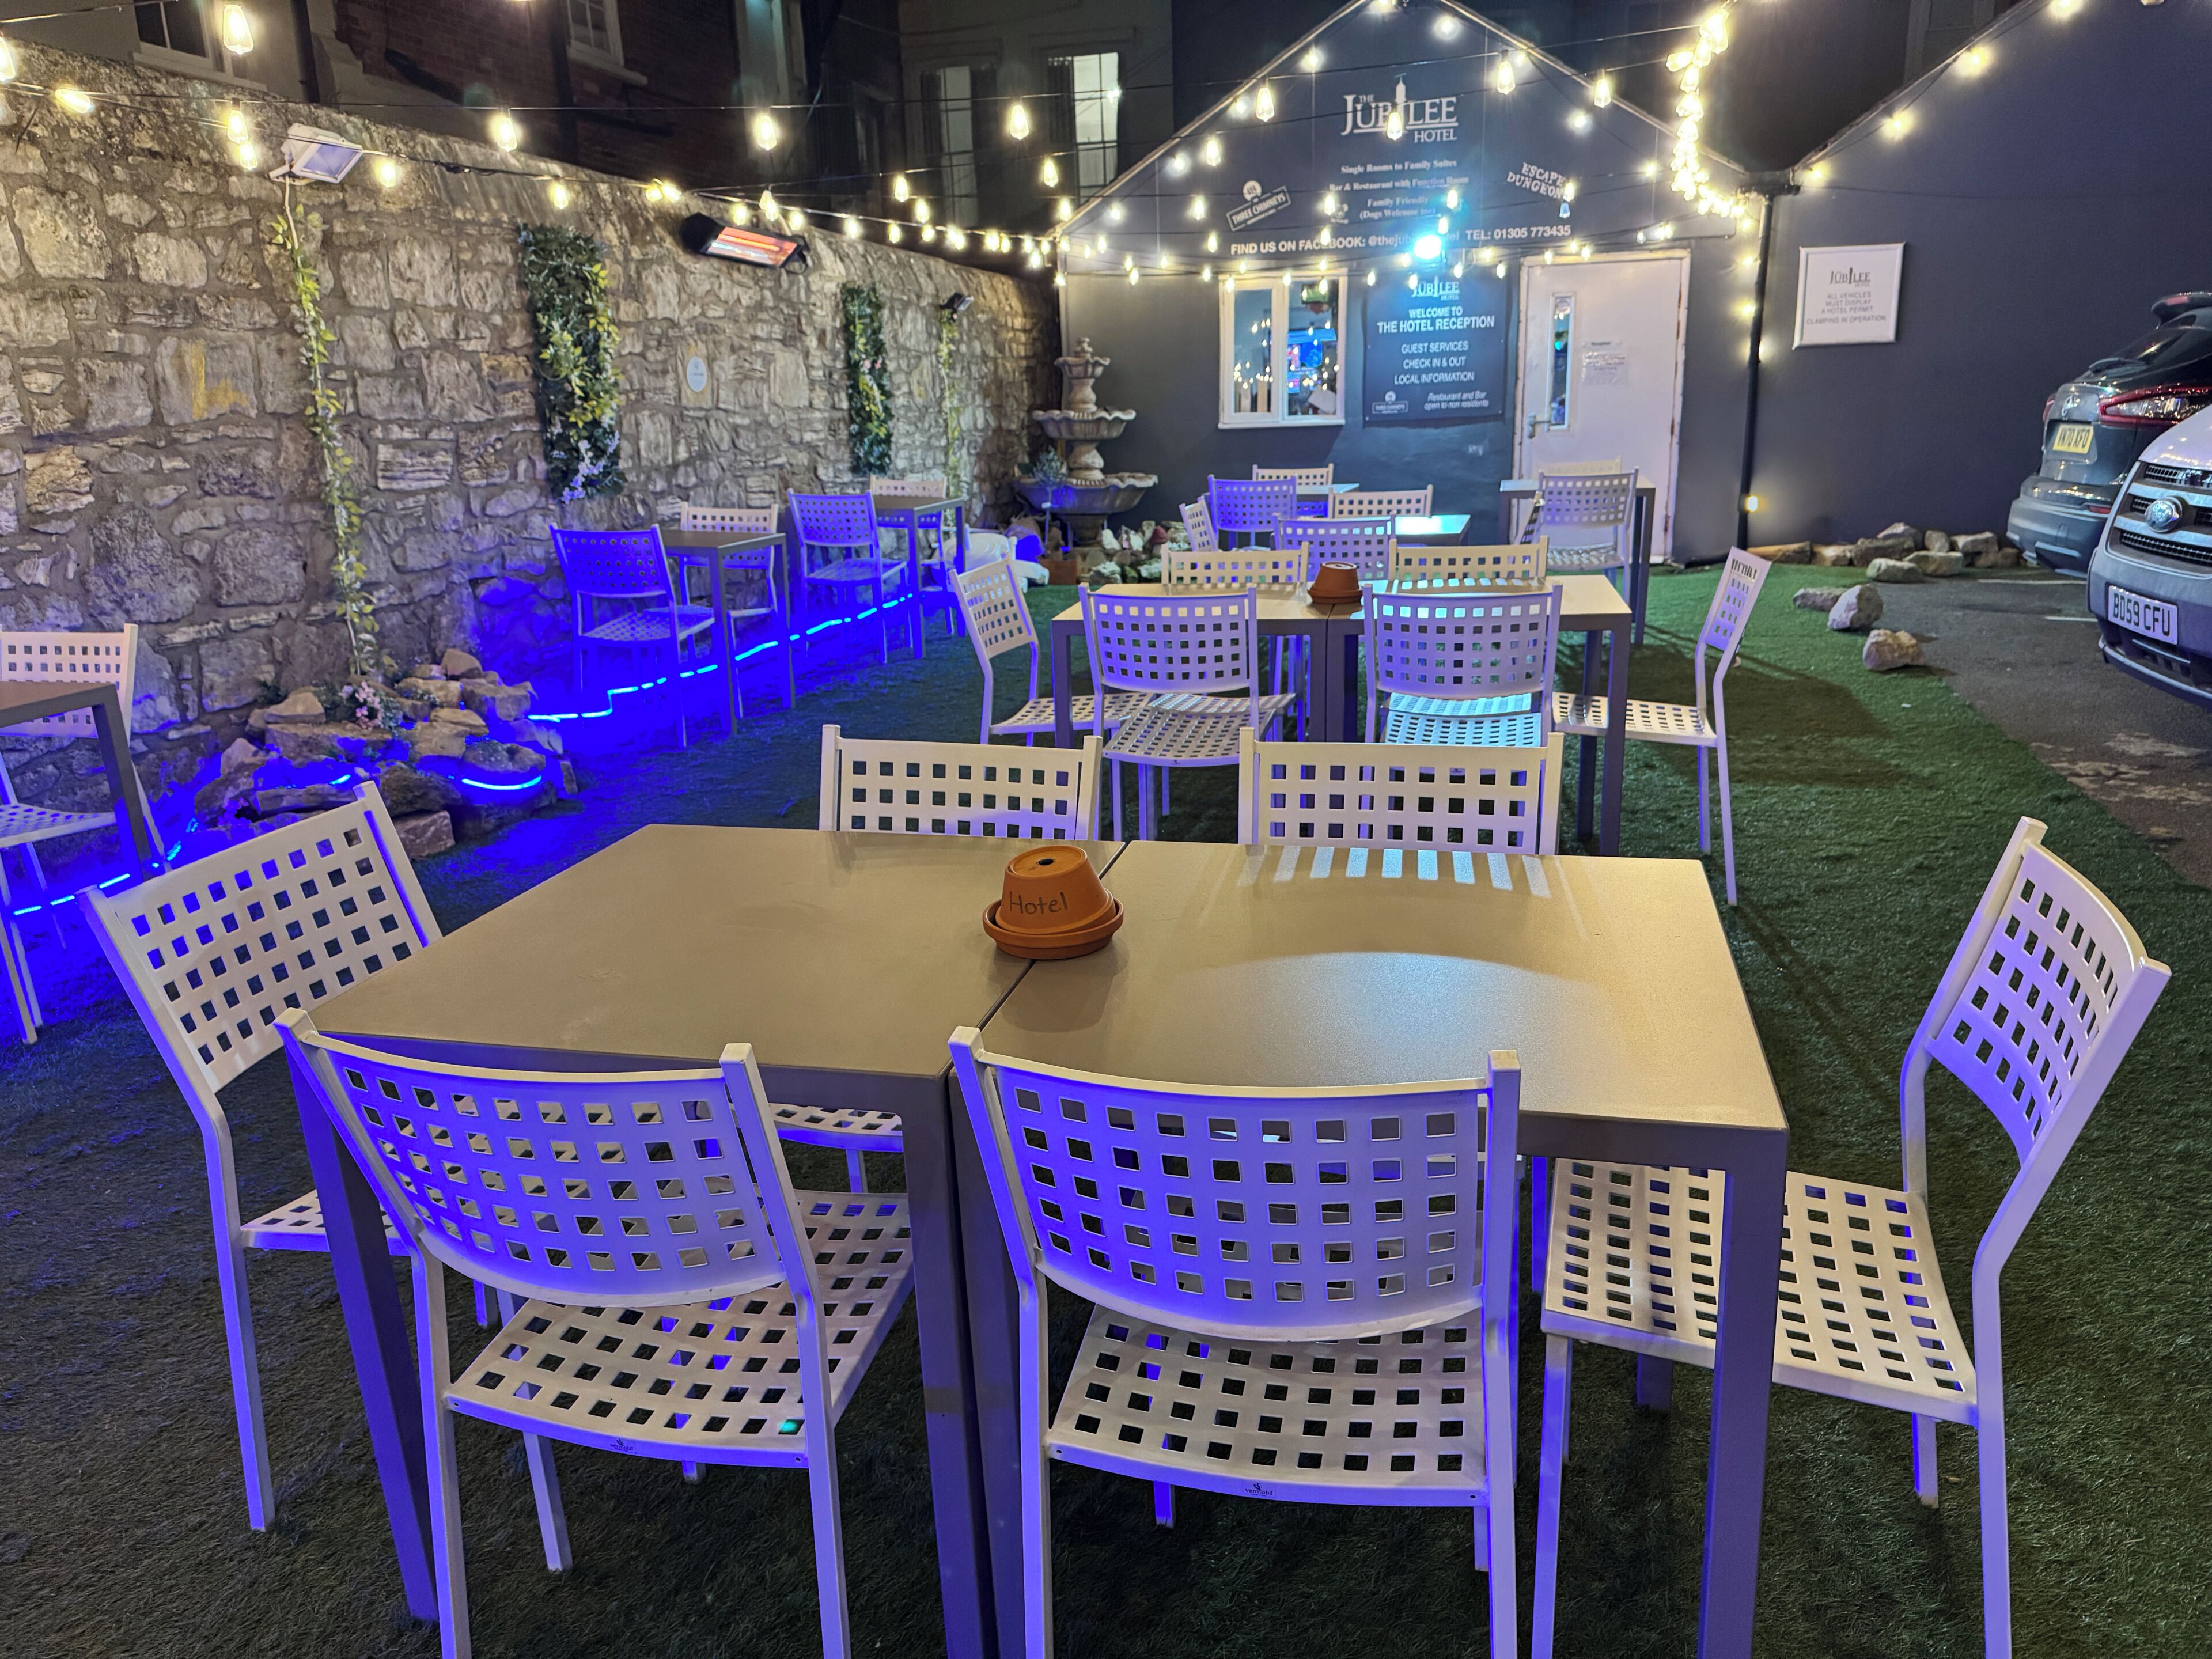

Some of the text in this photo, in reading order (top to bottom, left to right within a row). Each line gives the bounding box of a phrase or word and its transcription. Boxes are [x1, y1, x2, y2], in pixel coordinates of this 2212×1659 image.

[1359, 94, 1374, 103] THE
[1341, 82, 1459, 136] JUBILEE
[1414, 128, 1457, 143] HOTEL
[1341, 159, 1457, 175] Single Rooms to Family Suites
[1521, 162, 1567, 187] ESCAPE
[1506, 171, 1563, 199] DUNGEON
[1367, 198, 1393, 207] Family
[1230, 243, 1258, 255] FIND
[1260, 241, 1277, 254] US
[1278, 240, 1296, 252] ON
[1298, 236, 1366, 251] FACBOOK:
[1465, 229, 1491, 241] TEL:
[1493, 226, 1528, 240] 01305
[1530, 225, 1571, 238] 773435
[1830, 269, 1871, 284] JUBILEE
[1840, 291, 1871, 299] VEHICLES
[1844, 298, 1872, 306] DISPLAY
[1409, 306, 1463, 319] WELCOME TO
[1849, 305, 1873, 313] PERMIT
[1377, 316, 1495, 334] THE HOTEL RECEPTION
[1806, 317, 1839, 325] CLAMPING
[1849, 315, 1886, 323] OPERATION
[1401, 340, 1469, 354] GUEST SERVICES
[1403, 356, 1466, 369] CHECK IN & OUT
[1395, 372, 1475, 385] LOCAL INFORMATION
[1461, 391, 1475, 400] and
[2113, 592, 2171, 637] BD59 CFU
[1009, 891, 1068, 915] Hotel
